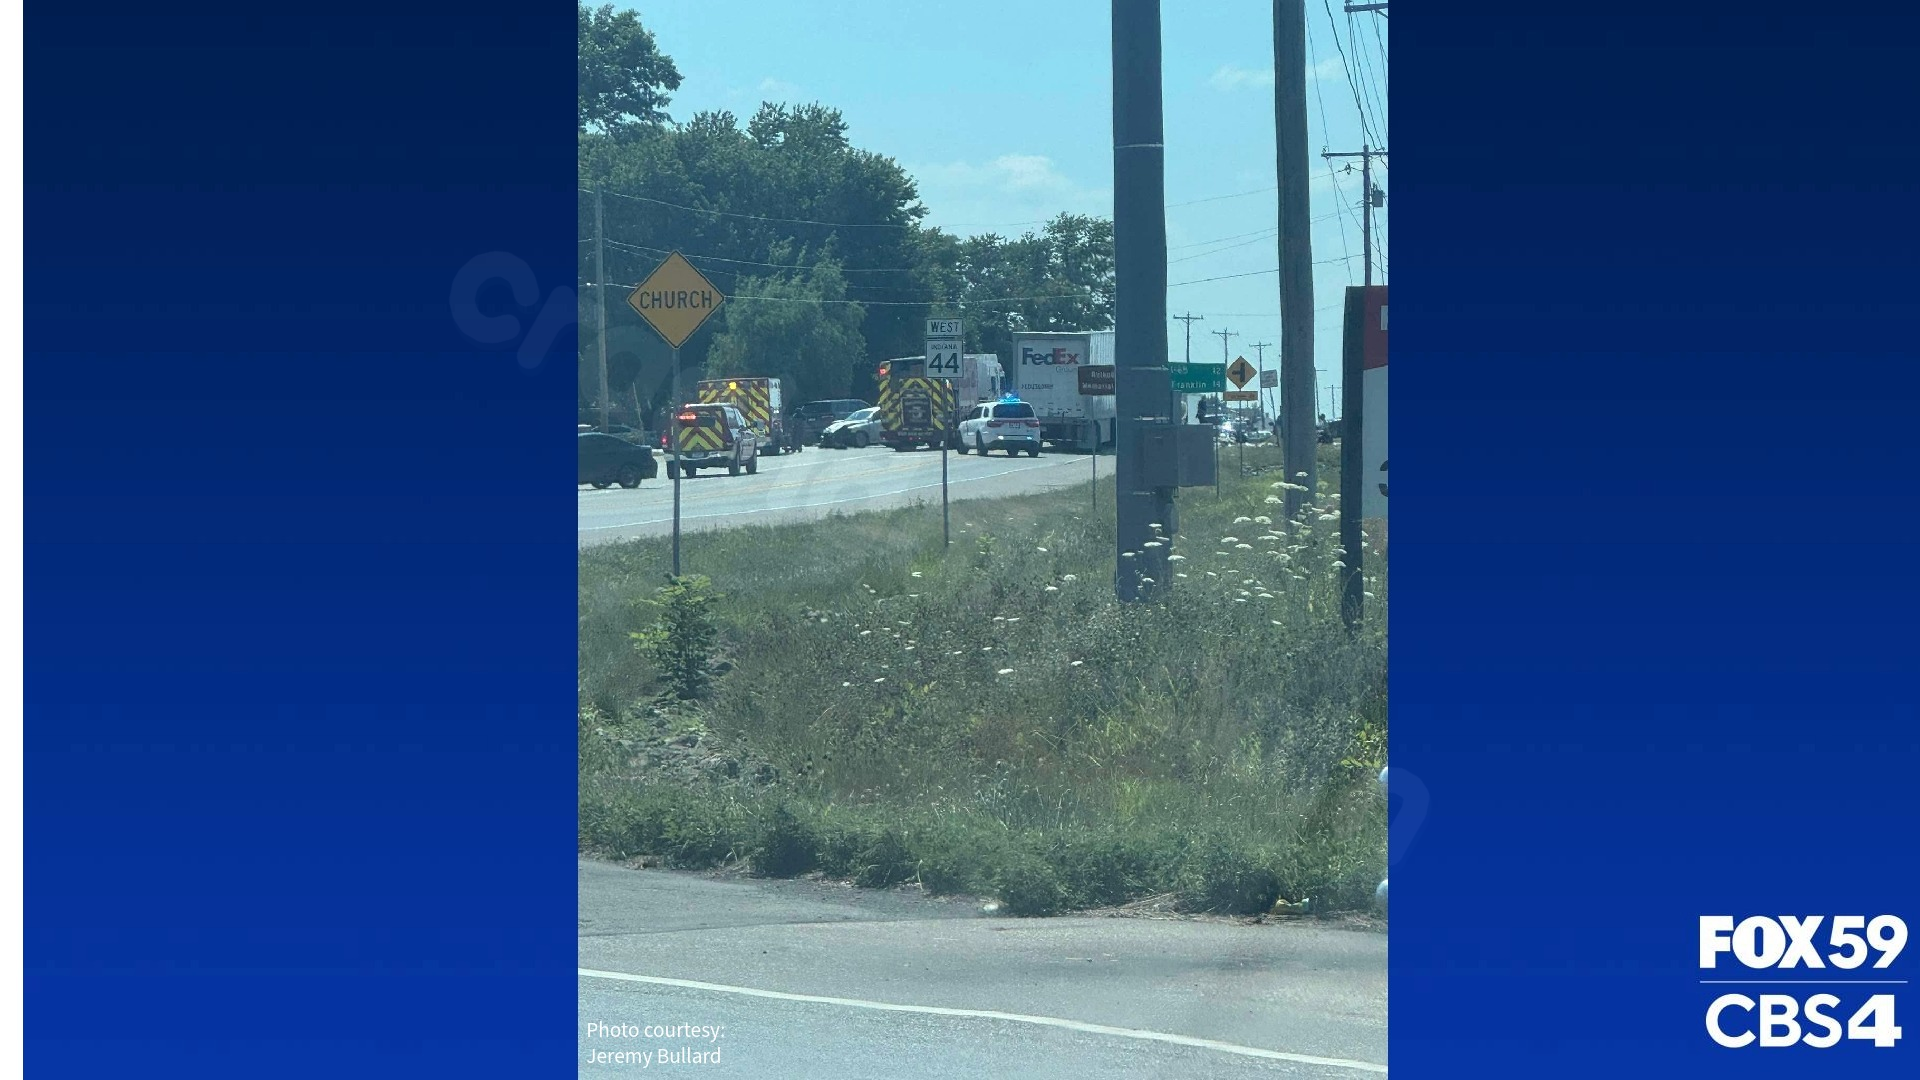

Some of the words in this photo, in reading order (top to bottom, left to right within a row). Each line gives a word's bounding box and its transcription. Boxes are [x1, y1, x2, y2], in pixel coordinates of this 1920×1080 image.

[640, 290, 712, 309] CHURCH
[931, 321, 960, 333] WEST
[928, 352, 960, 374] 44
[1022, 347, 1080, 366] FedEx
[1171, 380, 1207, 389] Franklin
